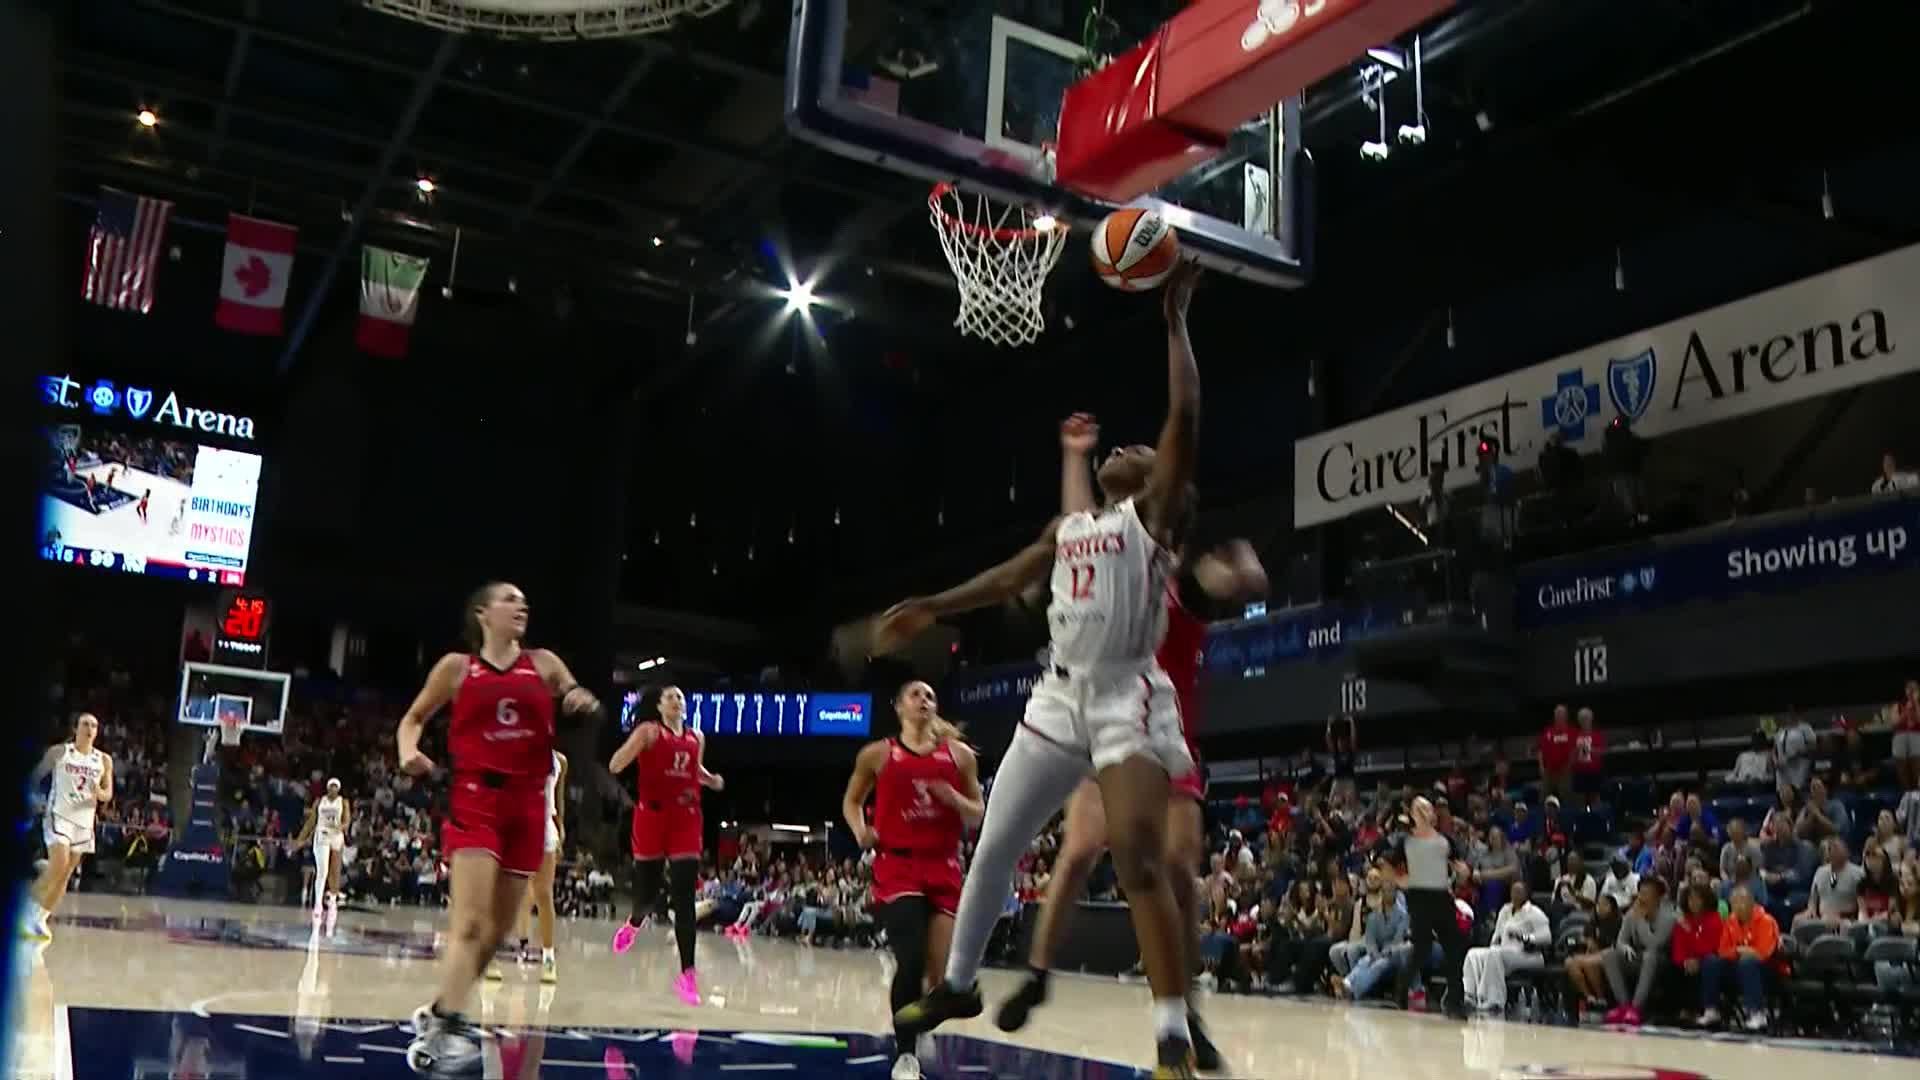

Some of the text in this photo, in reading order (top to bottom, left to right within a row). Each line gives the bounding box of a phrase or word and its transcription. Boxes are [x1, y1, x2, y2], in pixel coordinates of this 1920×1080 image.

[1672, 307, 1896, 410] Arena
[153, 391, 255, 440] Arena
[191, 496, 252, 519] BIRTHDAYS
[191, 522, 245, 546] MYSTICS
[1727, 525, 1907, 578] Showing up
[1071, 564, 1095, 601] 12
[1308, 620, 1341, 649] and
[1573, 644, 1608, 686] 113
[496, 697, 520, 726] 6
[1341, 679, 1367, 713] 113
